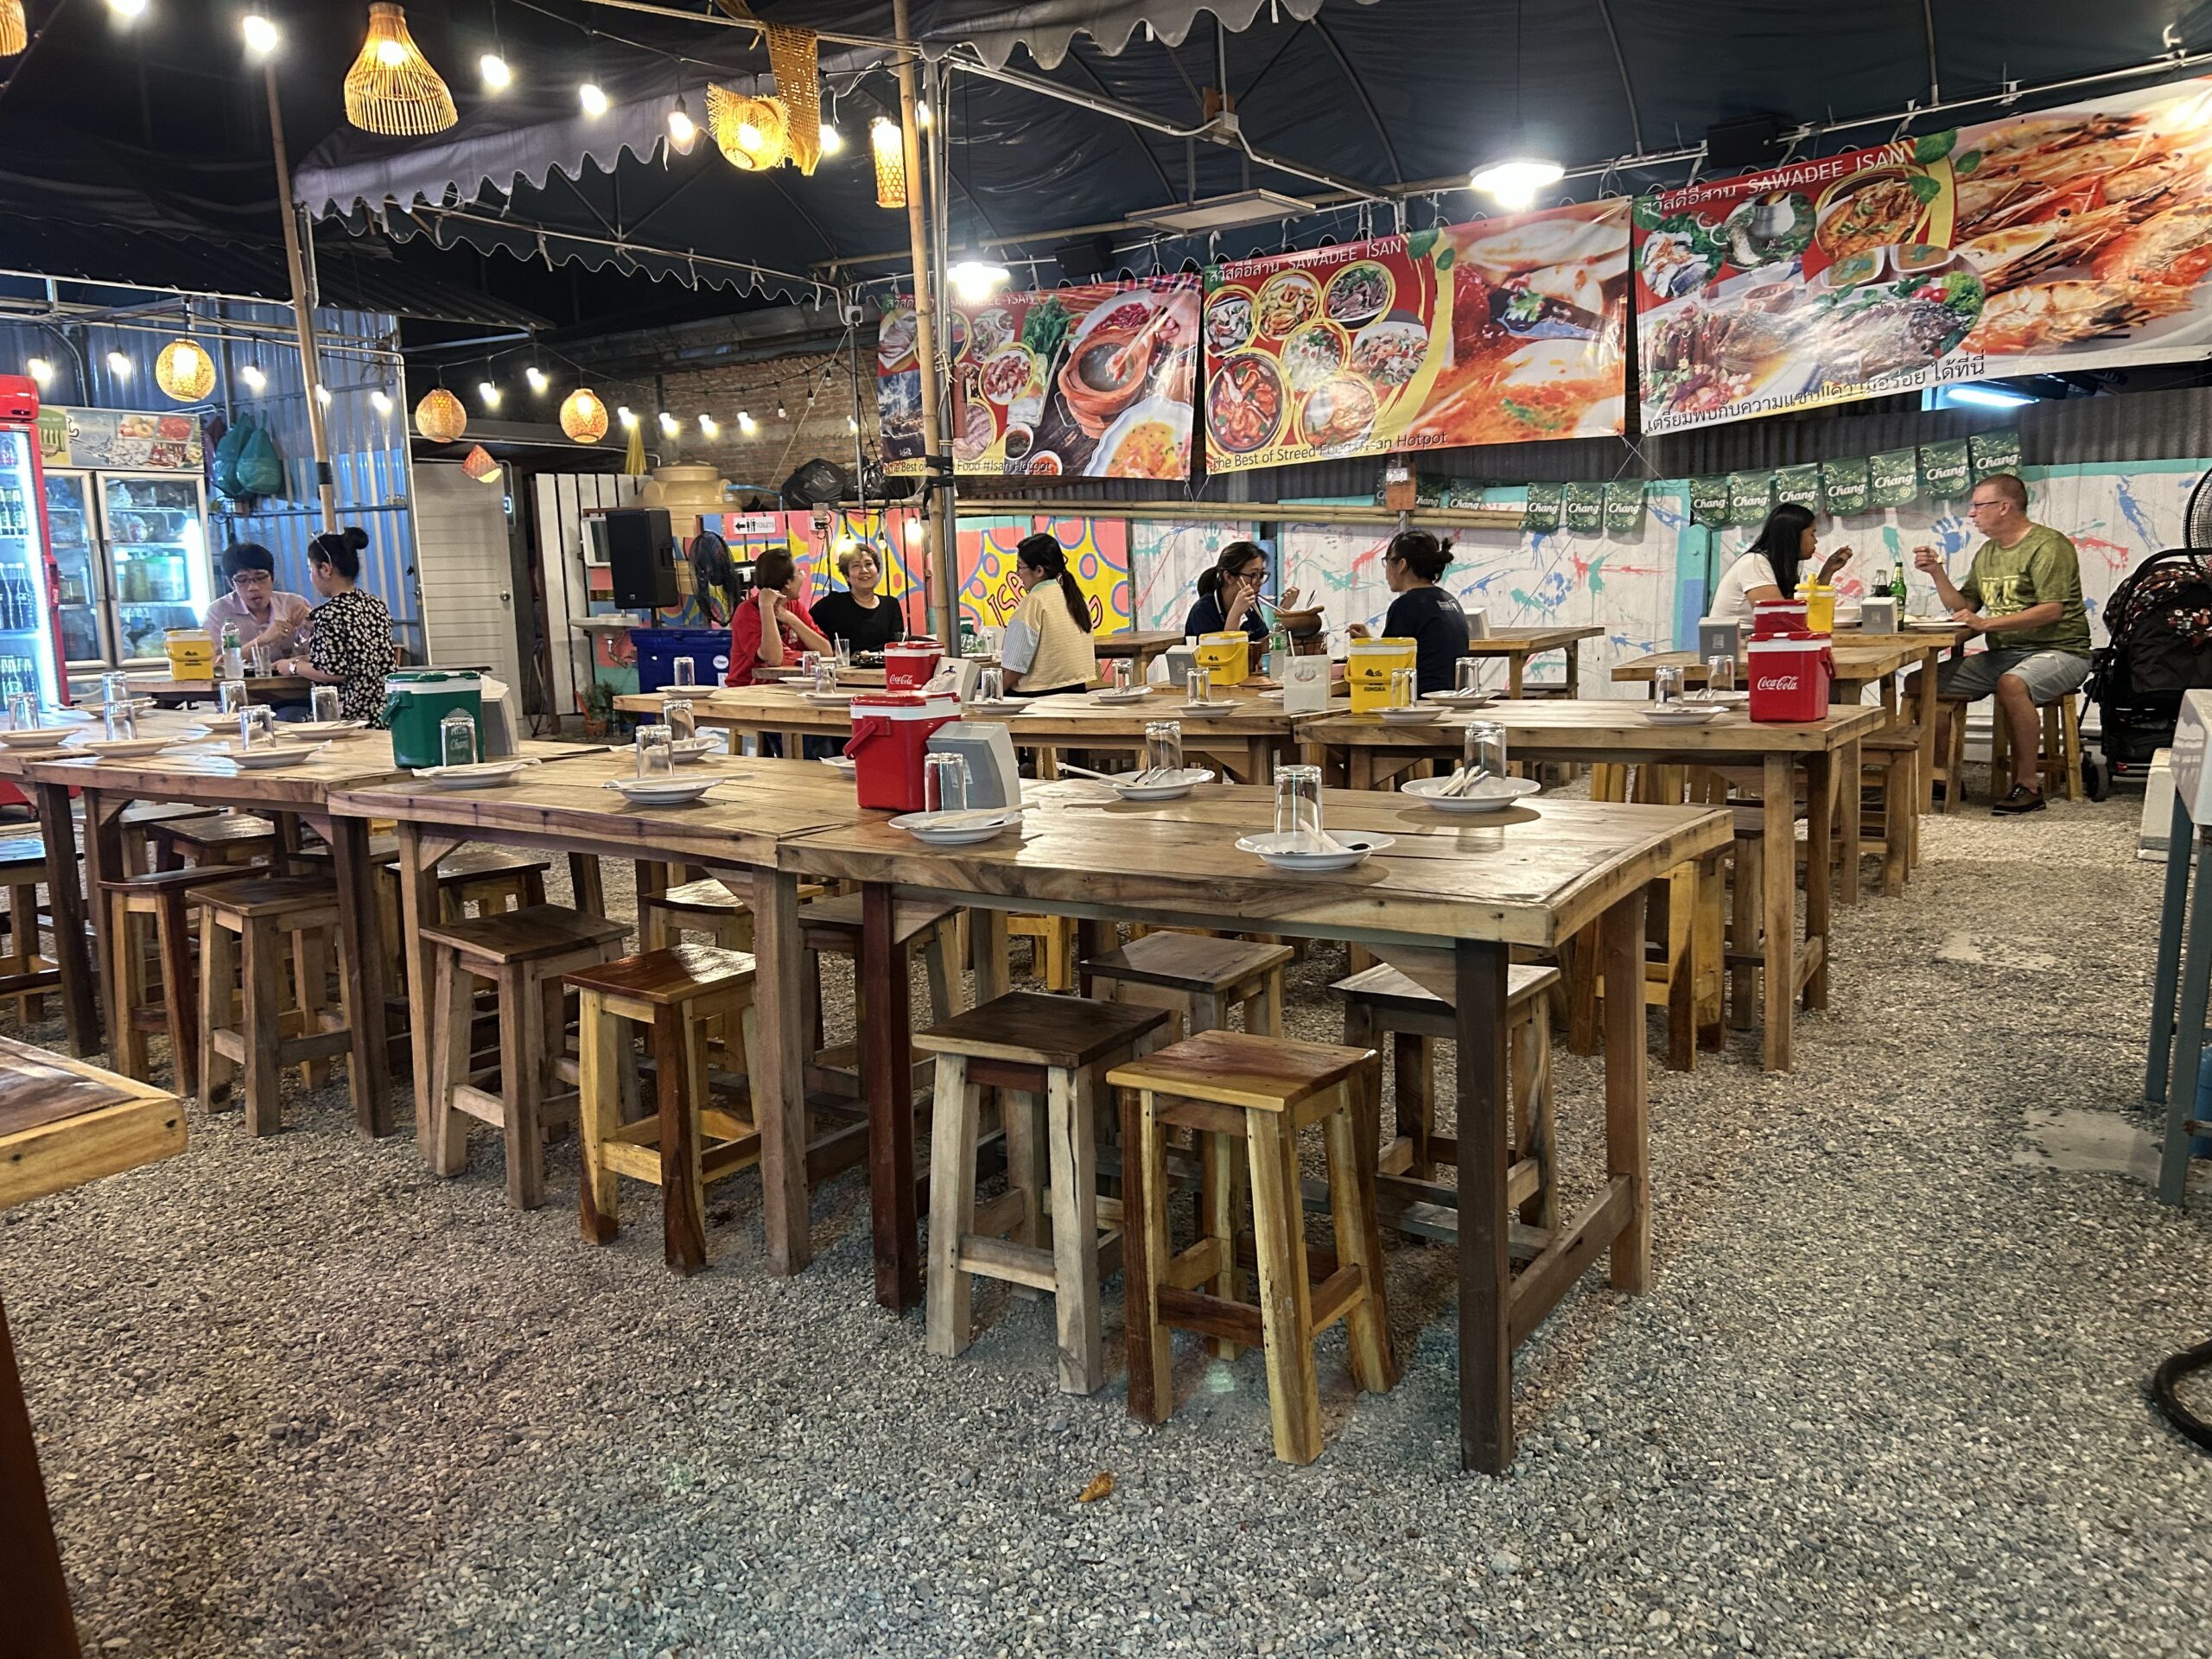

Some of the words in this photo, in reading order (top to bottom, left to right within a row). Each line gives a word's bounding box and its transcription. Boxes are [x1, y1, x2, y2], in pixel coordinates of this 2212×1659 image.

[1747, 160, 1845, 194] SAWADEE
[1856, 148, 1906, 172] ISAN
[1642, 186, 1737, 214] สวัสดีอีสาน
[1287, 246, 1357, 270] SAWADEE
[1366, 239, 1402, 258] ISAN
[1210, 258, 1280, 283] สวัสดีอีสาน
[1930, 348, 1985, 382] ได้ที่นี่
[1213, 456, 1231, 469] The
[1235, 454, 1259, 467] Best
[1262, 449, 1274, 463] of
[1277, 445, 1316, 461] Streed
[1396, 431, 1448, 448] Hotpot
[901, 461, 918, 473] Best
[1976, 453, 2019, 471] Chang
[1925, 464, 1968, 481] Chang
[1874, 474, 1916, 490] Chang
[1778, 489, 1816, 503] Chang
[1827, 483, 1866, 498] Chang
[1415, 495, 1440, 508] hang
[1450, 498, 1480, 511] Chang
[1528, 502, 1559, 515] Chang
[1567, 502, 1600, 515] Chang
[1608, 501, 1641, 514] Chang
[1693, 498, 1726, 509] Chang
[1732, 495, 1769, 508] Chang
[987, 570, 1028, 629] ISA
[1757, 675, 1798, 690] Coca-Cola
